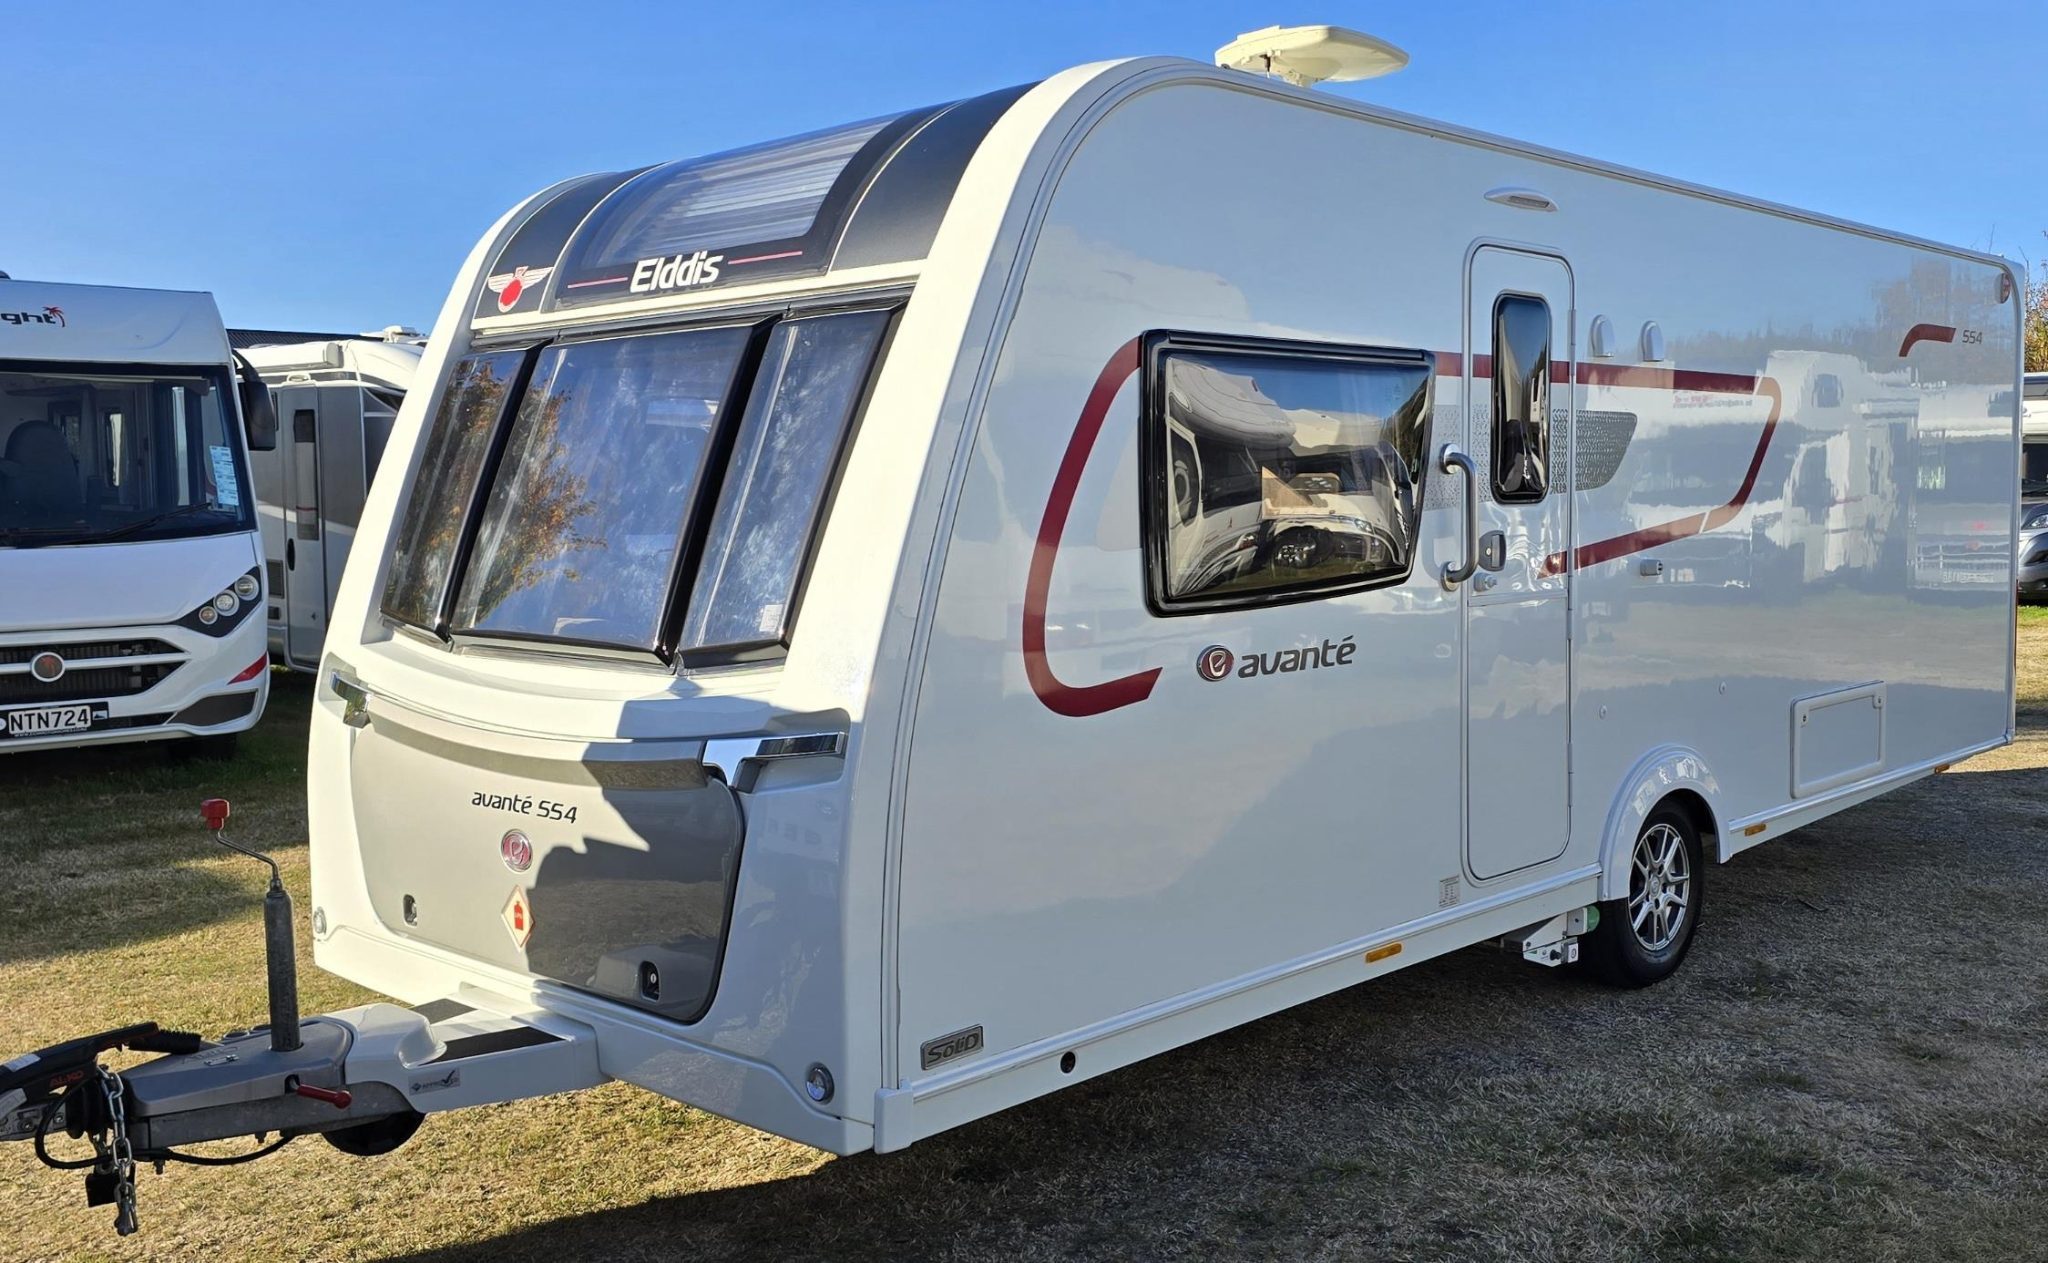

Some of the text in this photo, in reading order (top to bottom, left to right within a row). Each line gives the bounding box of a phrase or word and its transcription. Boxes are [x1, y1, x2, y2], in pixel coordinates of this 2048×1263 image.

[629, 250, 724, 293] Elddis
[1962, 330, 1983, 345] 554
[1237, 635, 1357, 679] avanté
[10, 708, 89, 732] NTN724
[471, 791, 578, 824] avanté 554
